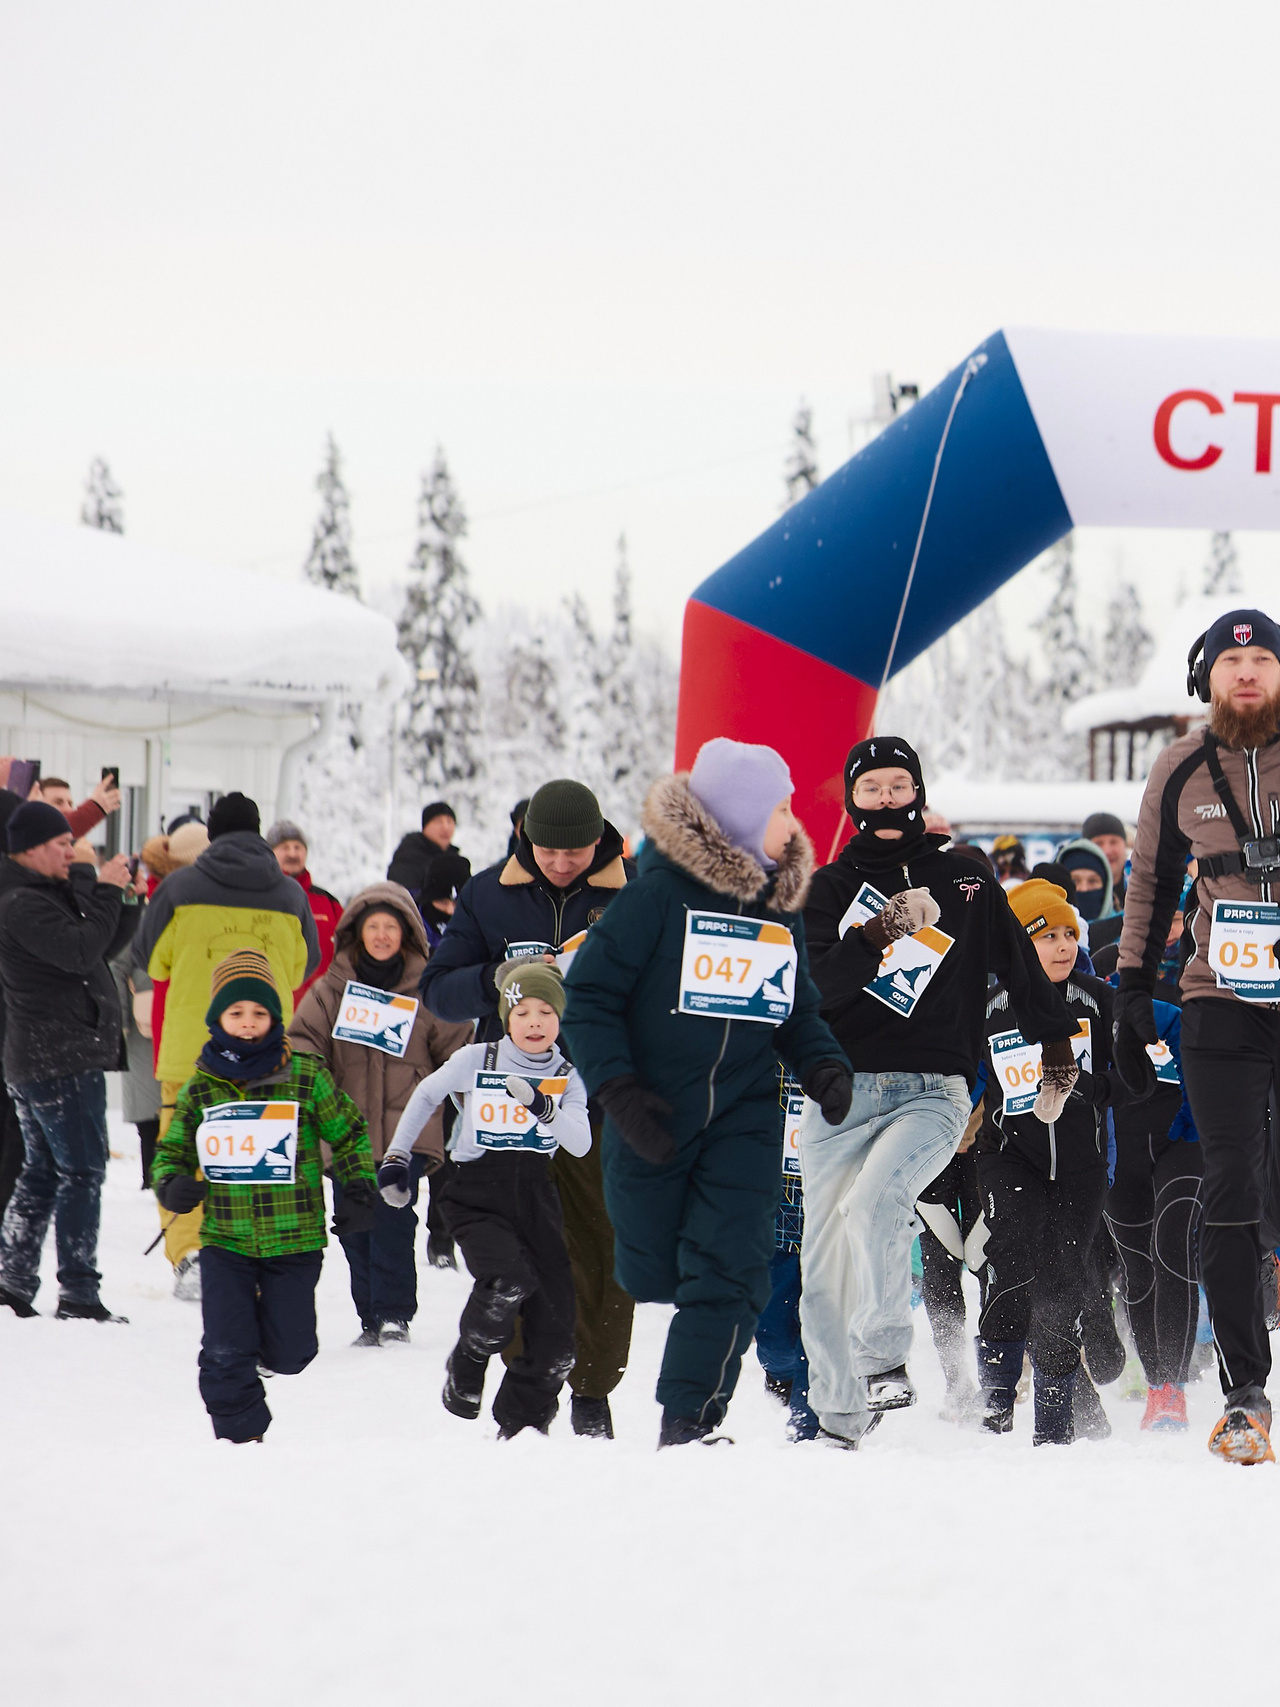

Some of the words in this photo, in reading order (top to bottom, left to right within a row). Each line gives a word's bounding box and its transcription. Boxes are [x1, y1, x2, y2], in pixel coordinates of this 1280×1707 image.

[1218, 941, 1275, 969] 051
[693, 954, 753, 984] 047
[1226, 981, 1275, 990] ВДОРСКИЙ
[345, 1006, 380, 1027] 021
[1012, 1093, 1039, 1105] КОВДОРС
[480, 1103, 528, 1124] 018
[206, 1135, 256, 1156] 014
